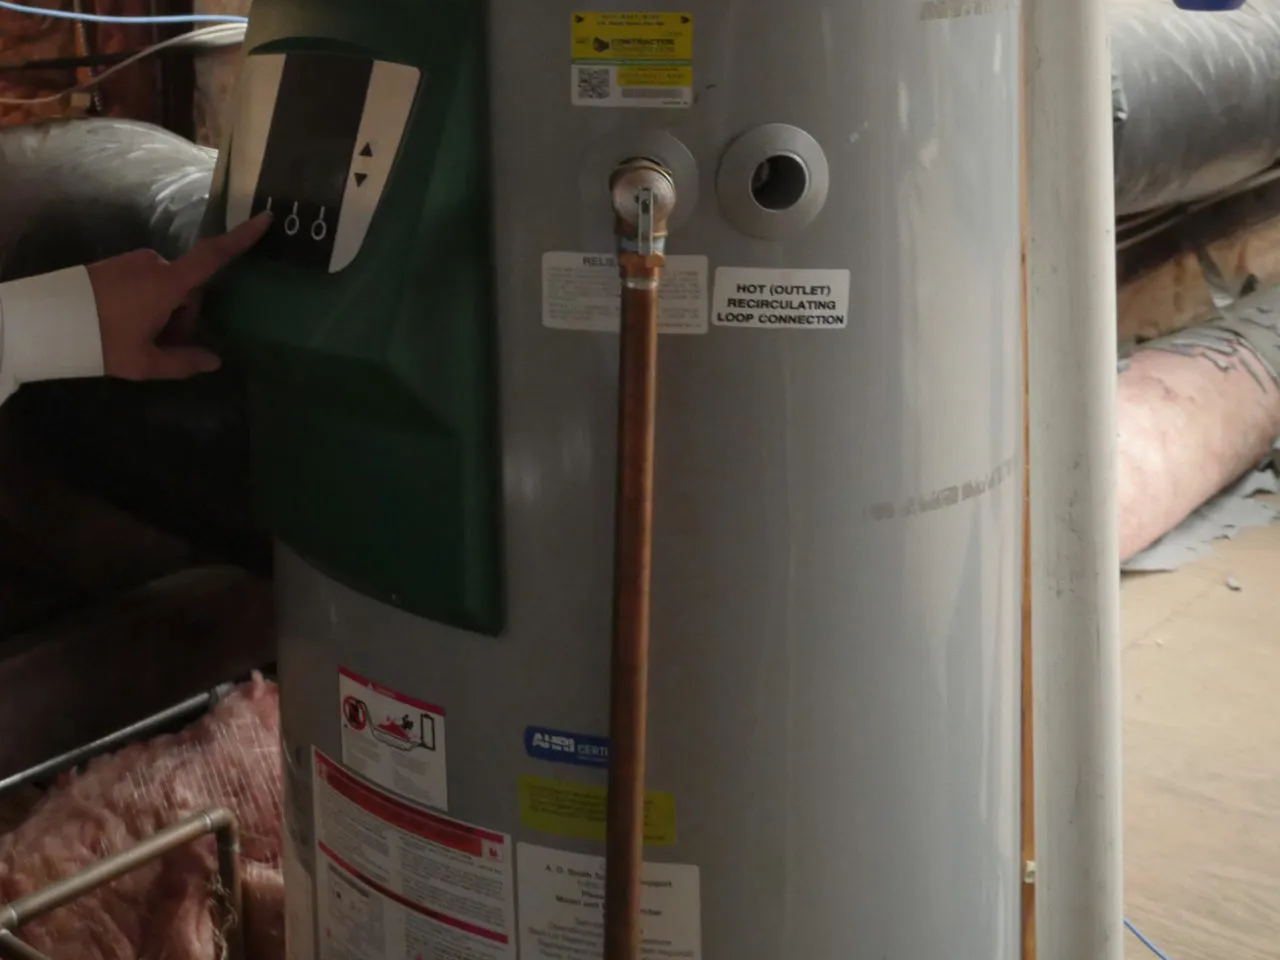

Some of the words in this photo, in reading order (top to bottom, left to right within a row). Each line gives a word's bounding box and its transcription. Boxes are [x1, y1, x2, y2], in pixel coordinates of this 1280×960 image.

[736, 283, 767, 295] HOT
[769, 283, 832, 297] (OUTLET)
[726, 297, 837, 311] RECIRCULATING
[716, 312, 755, 324] LOOP
[757, 313, 845, 326] CONNECTION
